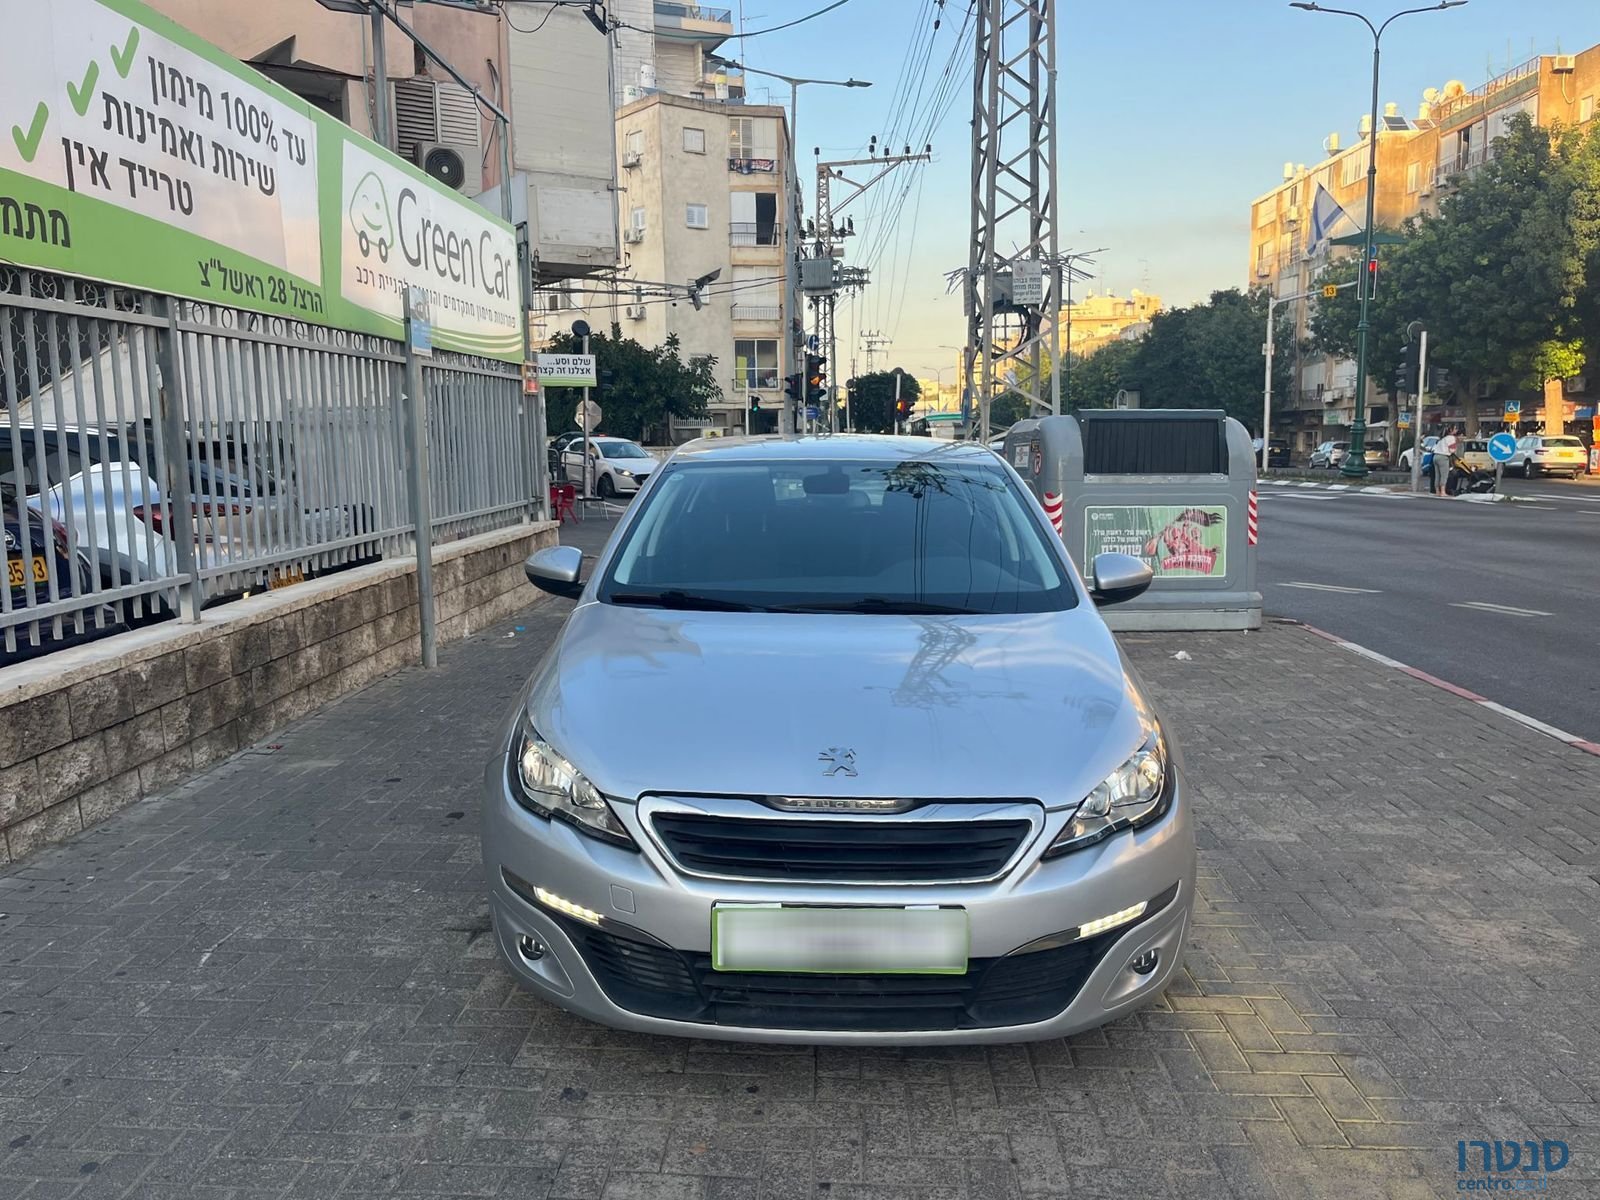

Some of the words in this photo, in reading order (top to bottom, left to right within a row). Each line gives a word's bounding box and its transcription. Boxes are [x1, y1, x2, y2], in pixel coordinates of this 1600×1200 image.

[148, 56, 214, 121] מימון
[102, 91, 205, 168] ואמינות
[221, 91, 278, 152] 100%
[62, 137, 112, 192] אין
[212, 141, 275, 196] שירות
[282, 128, 305, 166] עד
[119, 157, 194, 216] טרייד
[397, 188, 476, 289] Green
[479, 230, 511, 301] Car
[268, 275, 287, 305] 28
[290, 280, 324, 314] הרצל
[356, 266, 375, 287] רכב
[1325, 287, 1334, 295] 13
[568, 366, 591, 374] אצלנו
[572, 357, 591, 365] שלם
